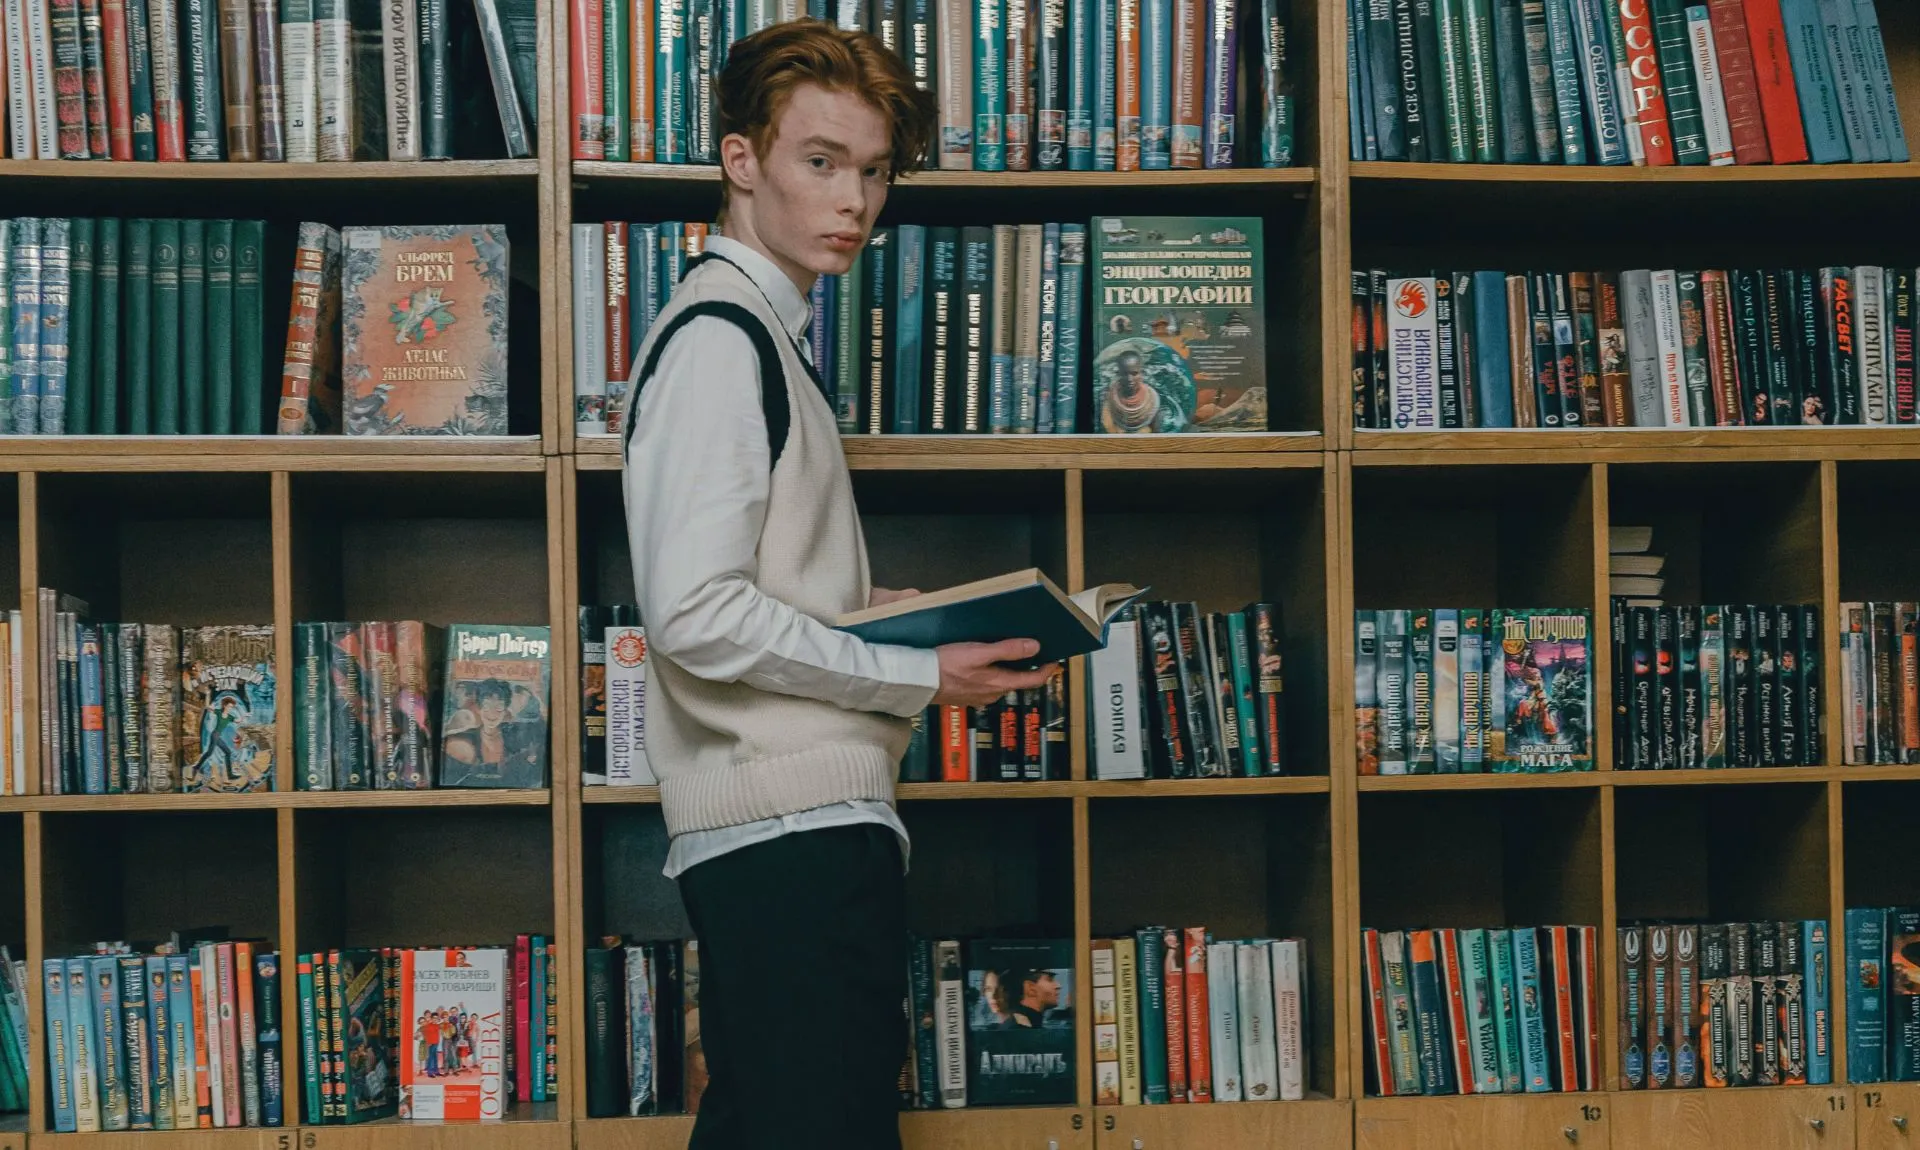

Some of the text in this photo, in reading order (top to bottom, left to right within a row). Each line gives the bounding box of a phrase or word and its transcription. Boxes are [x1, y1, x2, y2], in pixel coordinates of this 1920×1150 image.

[1182, 29, 1195, 119] ЭНЦИКЛОПЕДИЯ
[1398, 11, 1421, 123] ВСЕ СТОЛИЦЫ
[1695, 26, 1715, 81] СТРАНЫ МИРА
[392, 36, 410, 151] ЭНЦИКЛОПЕДИЯ
[698, 15, 711, 154] ЭНЦИКЛОПЕДИЯ ДЛЯ ДЕТЕЙ
[1277, 95, 1287, 125] ХИМИЯ
[1553, 59, 1572, 120] РОССИИ
[1590, 45, 1618, 139] ОТЕЧЕСТВО
[396, 264, 455, 282] БРЕМ
[398, 251, 455, 264] АЛЬФРЕД
[1103, 265, 1252, 280] ЭНЦИКЛОПЕДИЯ
[1103, 286, 1253, 304] ГЕОГРАФИИ
[1742, 276, 1758, 347] сумерки
[1802, 275, 1818, 347] затмение
[1834, 278, 1853, 355] РАССВЕТ
[1897, 294, 1908, 317] ИСХОД
[382, 366, 468, 381] ЖИВОТНЫХ
[402, 349, 448, 363] АТЛАС
[932, 291, 949, 430] ЭНЦИКЛОПЕДИЯ ДЛЯ ДЕТЕЙ
[965, 293, 981, 431] ЭНЦИКЛОПЕДИЯ ДЛЯ ДЕТЕЙ
[1057, 327, 1076, 403] МУЗЫКА
[1863, 308, 1885, 423] СТРУГАЦКИЕ
[1894, 326, 1914, 421] СТИВЕН КИНГ
[1528, 615, 1586, 643] ПЕРУМОВ
[1111, 683, 1127, 754] БУШКОВ
[1387, 673, 1403, 728] ПЕРУМОВ
[1414, 671, 1431, 726] ПЕРУМОВ
[1462, 671, 1480, 726] ПЕРУМОВ
[1520, 744, 1573, 753] РОЖДЕНИЕ
[1520, 754, 1574, 767] МАГА
[130, 968, 143, 997] ЕМЕЦ
[946, 986, 962, 1085] ГРИГОРИЙ РАСПУТИН
[1713, 1006, 1723, 1065] ЮРИЙ НИКИТИН
[1738, 1003, 1748, 1061] ЮРИЙ НИКИТИН
[1765, 1004, 1775, 1062] ЮРИЙ НИКИТИН
[1790, 1002, 1800, 1060] ЮРИЙ НИКИТИН
[1903, 1022, 1913, 1048] ГОРЕ
[480, 1011, 501, 1116] ОСЕЕВА
[1071, 1113, 1083, 1130] 8
[1104, 1114, 1116, 1131] 9
[1580, 1104, 1601, 1121] 10
[1827, 1095, 1846, 1111] 11
[1863, 1092, 1882, 1108] 12
[304, 1132, 316, 1148] 6
